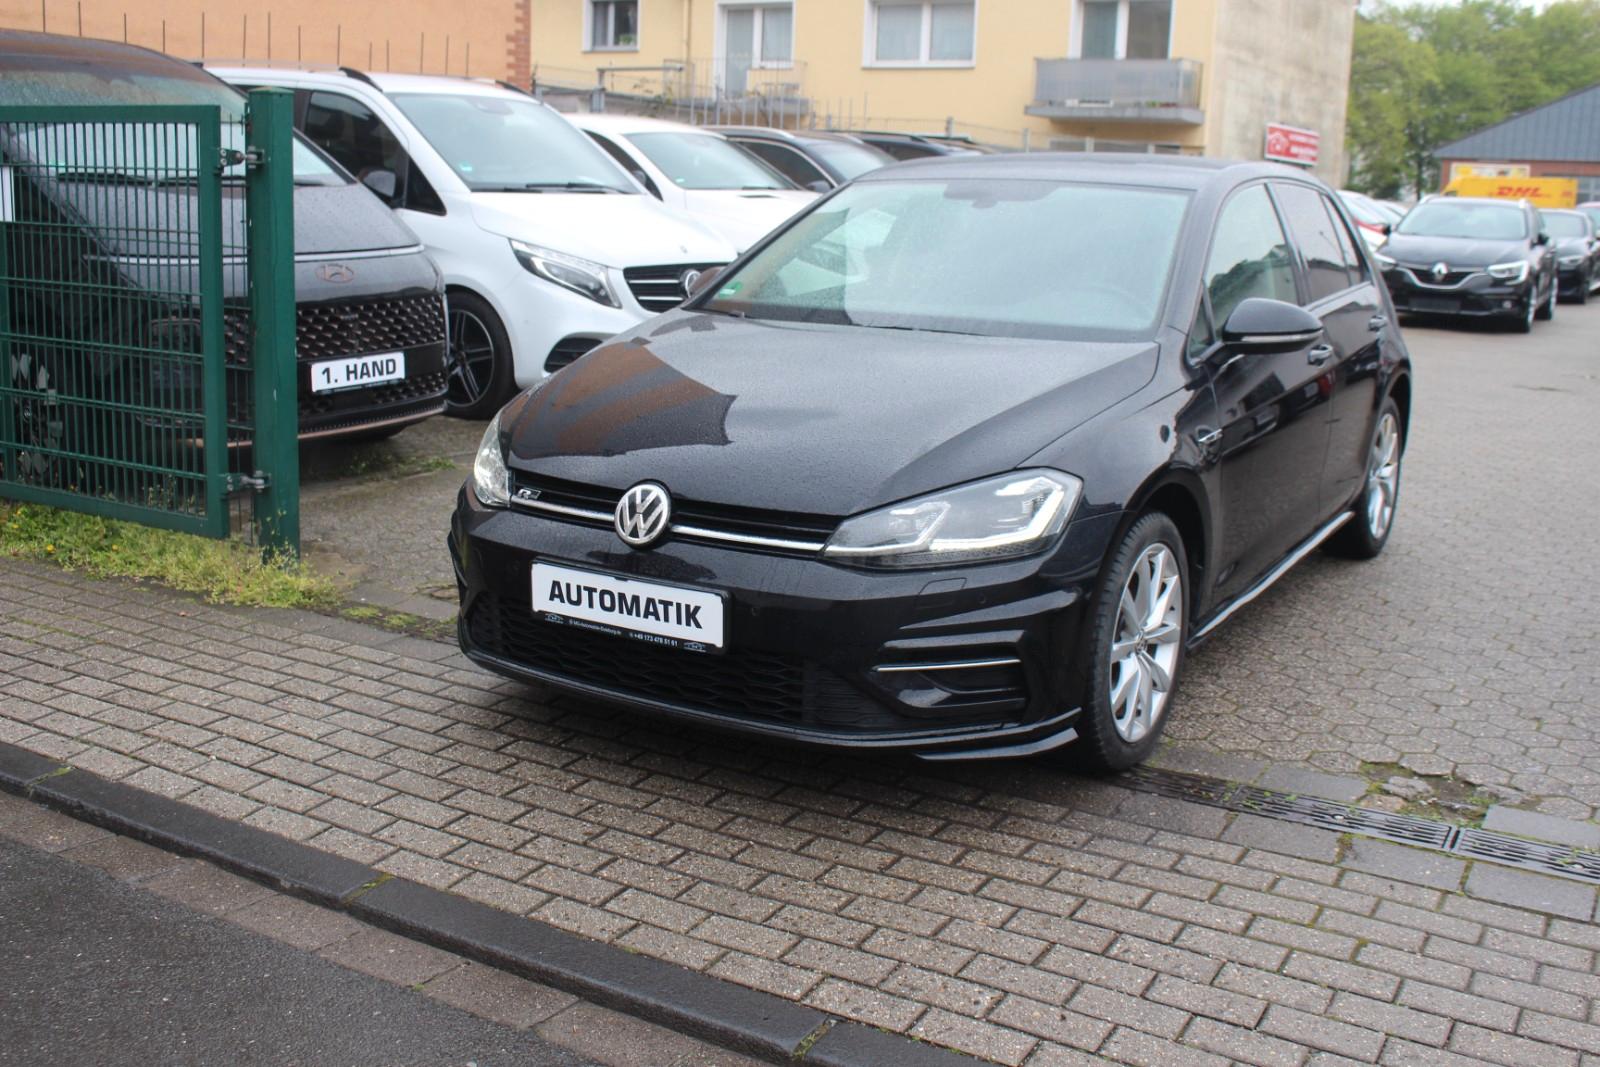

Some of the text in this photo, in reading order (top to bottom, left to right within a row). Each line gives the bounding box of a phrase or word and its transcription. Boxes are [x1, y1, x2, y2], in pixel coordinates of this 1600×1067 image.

[1496, 186, 1541, 198] DHL
[321, 358, 396, 384] 1. HAND
[548, 580, 703, 629] AUTOMATIK
